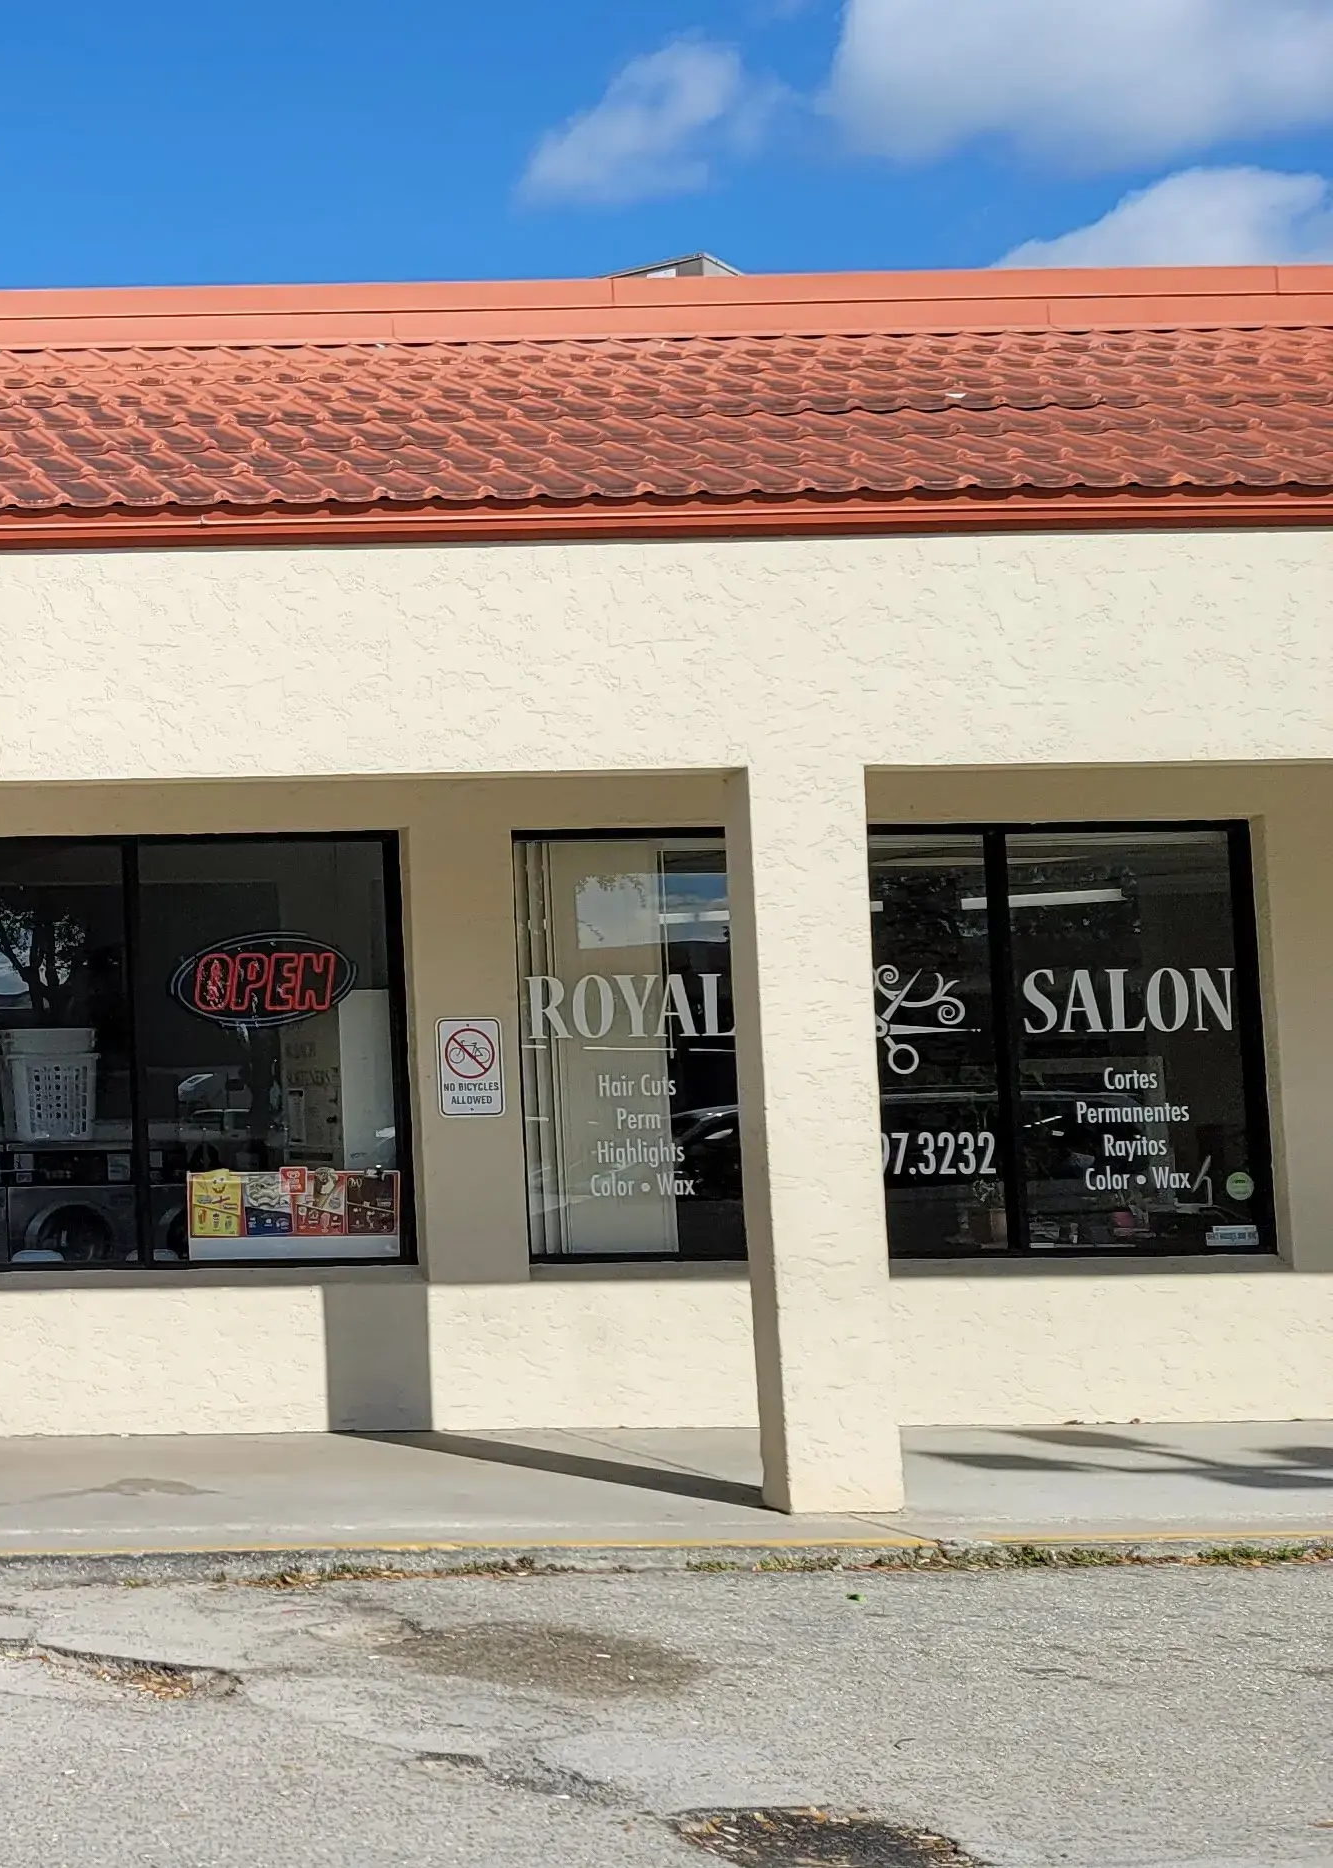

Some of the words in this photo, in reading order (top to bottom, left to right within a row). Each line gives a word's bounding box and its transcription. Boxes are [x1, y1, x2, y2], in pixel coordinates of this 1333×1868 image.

[195, 953, 335, 1011] OPEN
[524, 972, 736, 1040] ROYAL
[1023, 967, 1235, 1034] SALON
[443, 1082, 456, 1092] NO
[458, 1081, 500, 1092] BICYCLES
[598, 1074, 635, 1097] Hair
[640, 1074, 677, 1097] Cuts
[1104, 1067, 1158, 1090] Cortes
[450, 1095, 493, 1106] ALLOWED
[617, 1109, 661, 1130] Perm
[1076, 1101, 1190, 1124] Permanentes
[596, 1140, 685, 1168] Highlights
[1103, 1134, 1168, 1163] Rayitos
[590, 1174, 635, 1197] Color
[658, 1174, 695, 1197] Wax
[1085, 1166, 1130, 1191] Color
[1152, 1166, 1191, 1190] Wax
